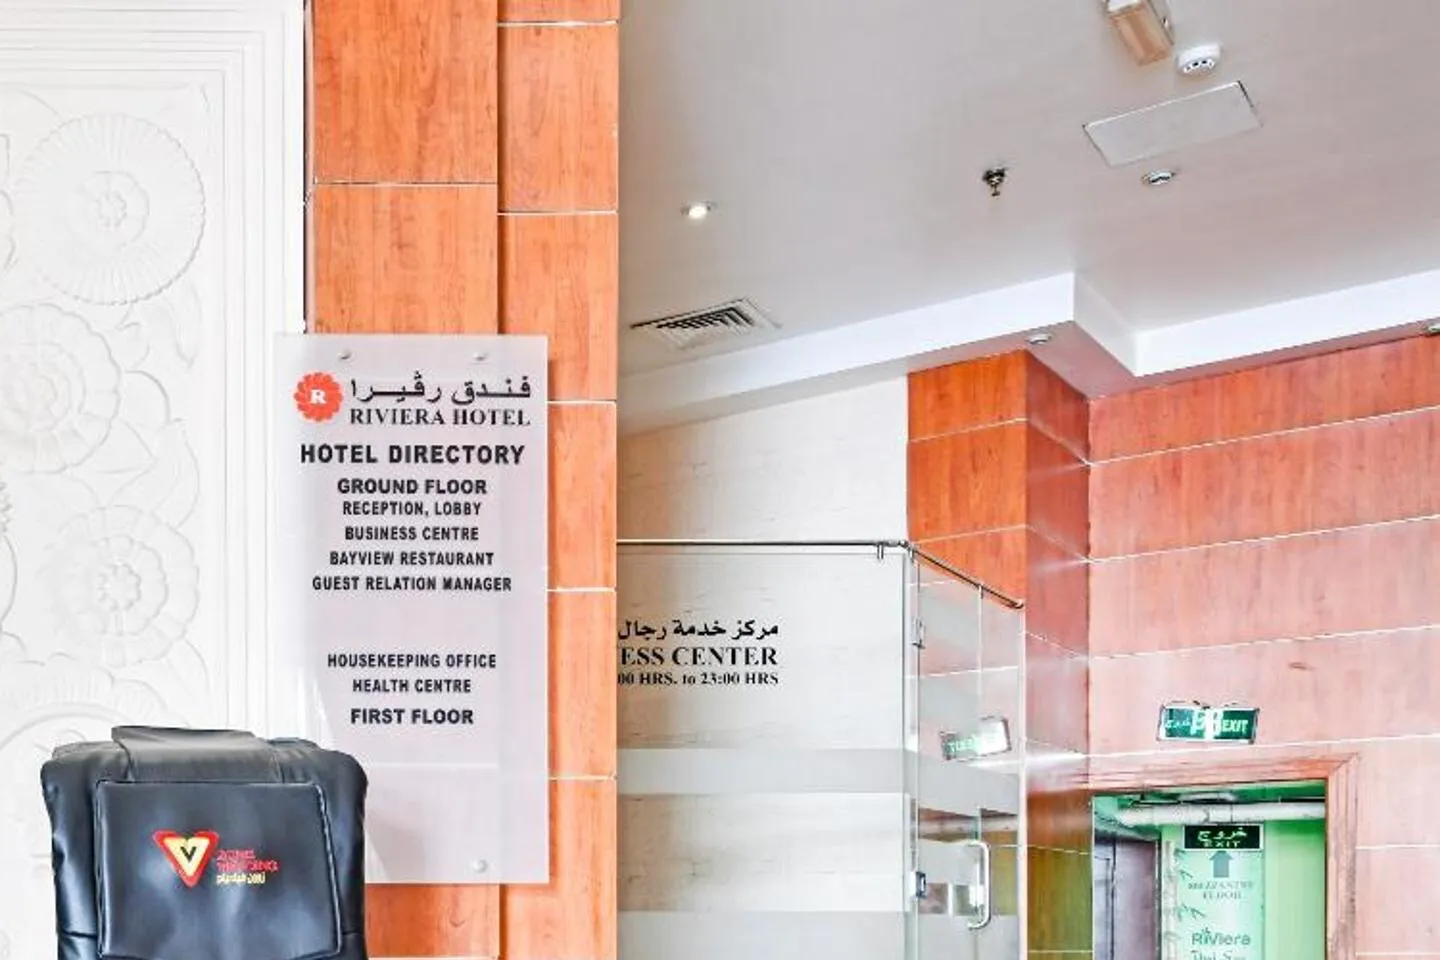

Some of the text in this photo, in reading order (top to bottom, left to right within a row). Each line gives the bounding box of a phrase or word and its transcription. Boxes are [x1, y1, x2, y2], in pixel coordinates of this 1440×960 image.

[451, 376, 531, 405] فندق
[350, 408, 531, 425] RIVIERA HOTEL
[300, 444, 525, 464] HOTEL DIRECTORY
[337, 479, 487, 494] GROUND FLOOR
[343, 501, 482, 517] RECEPTION, LOBBY
[345, 527, 479, 541] BUSINESS CENTRE
[330, 552, 494, 566] BAYVIEW RESTAURANT
[312, 577, 511, 591] GUEST RELATION MANAGER
[617, 619, 778, 640] مركز خدمة رجال
[328, 654, 496, 668] HOUSEKEEPING OFFICE
[672, 646, 778, 666] CENTER
[352, 679, 471, 692] HEALTH CENTRE
[640, 672, 677, 684] HRS.
[682, 672, 695, 684] to
[700, 672, 739, 684] 23:00
[745, 672, 778, 684] HRS
[351, 709, 474, 724] FIRST FLOOR
[1222, 720, 1249, 733] EXIT
[1198, 827, 1247, 842] خروج
[1203, 840, 1240, 848] EXIT
